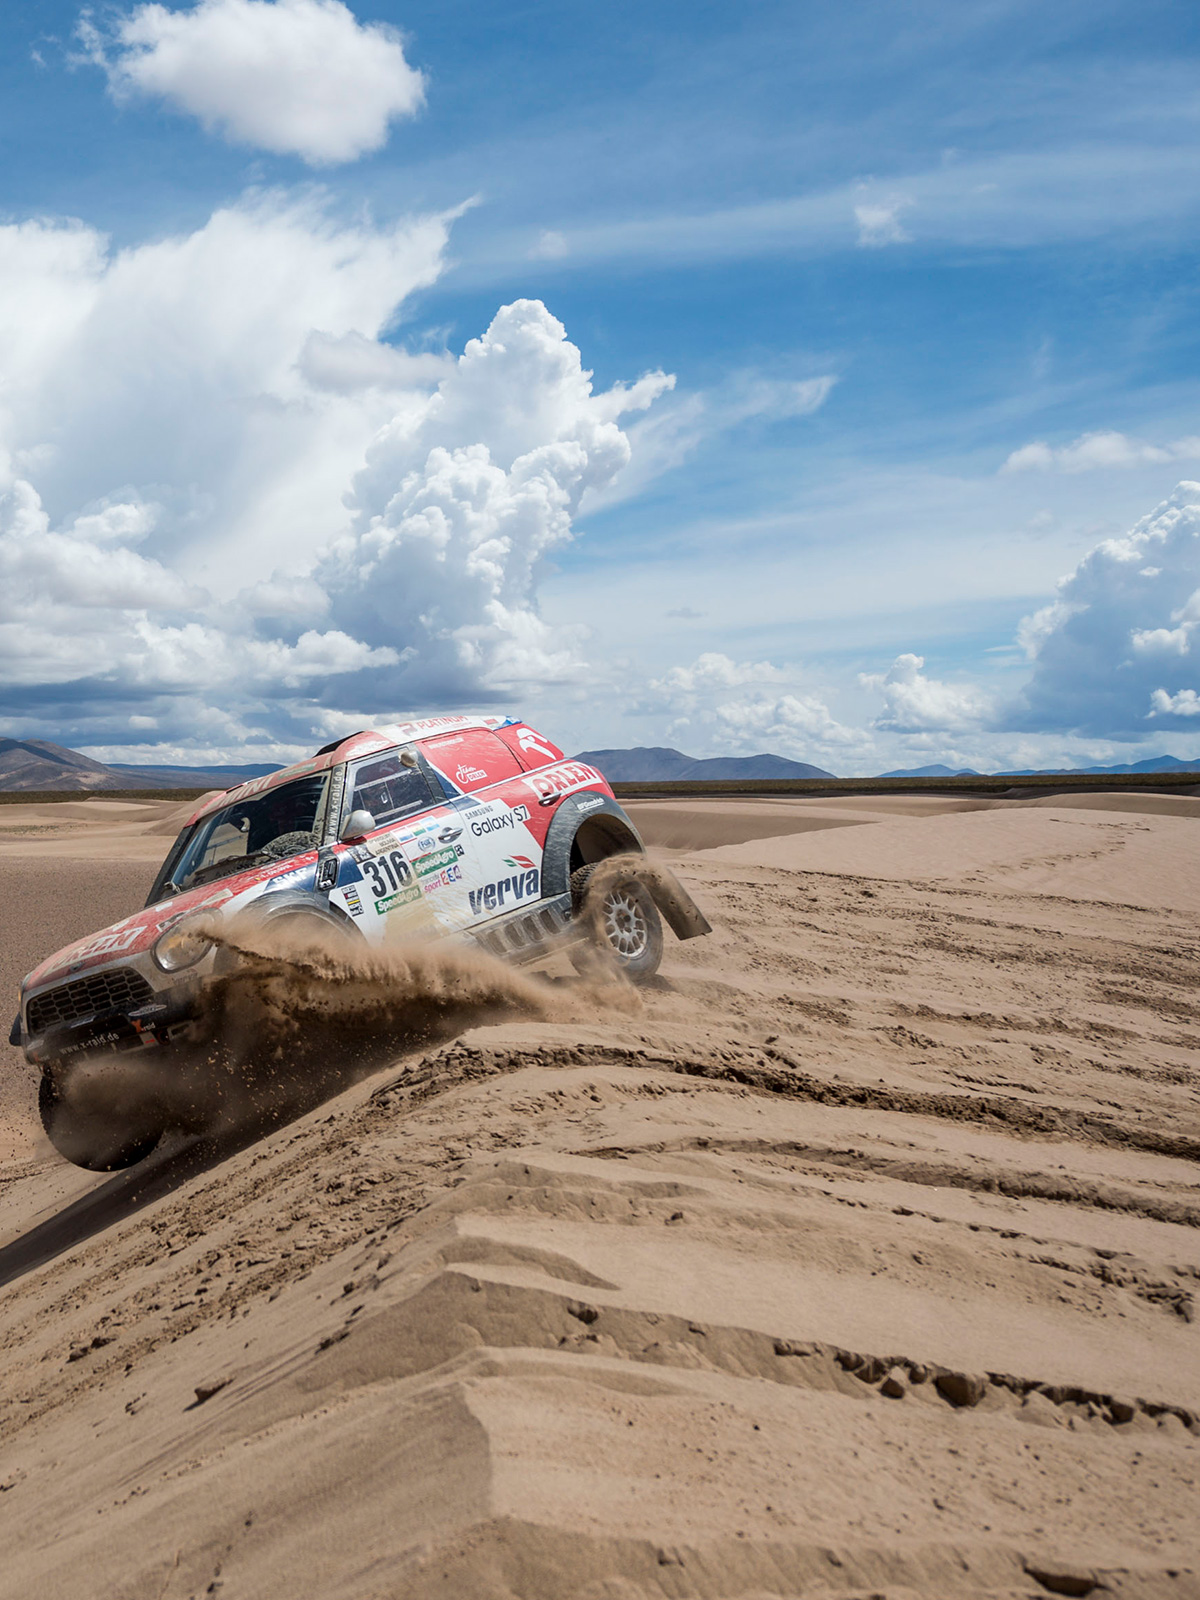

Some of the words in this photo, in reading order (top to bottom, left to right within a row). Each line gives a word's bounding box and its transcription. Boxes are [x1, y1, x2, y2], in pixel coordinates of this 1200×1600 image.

[416, 716, 469, 729] PLATINUM
[531, 763, 597, 795] ORLEN
[328, 770, 343, 834] www.x-raid.de
[465, 805, 494, 820] SAMSUNG
[471, 812, 515, 837] Galaxy
[514, 805, 528, 822] S7
[363, 851, 413, 898] 316
[424, 879, 441, 893] sport
[468, 869, 540, 915] verva
[60, 1032, 120, 1055] www.x-raid.de
